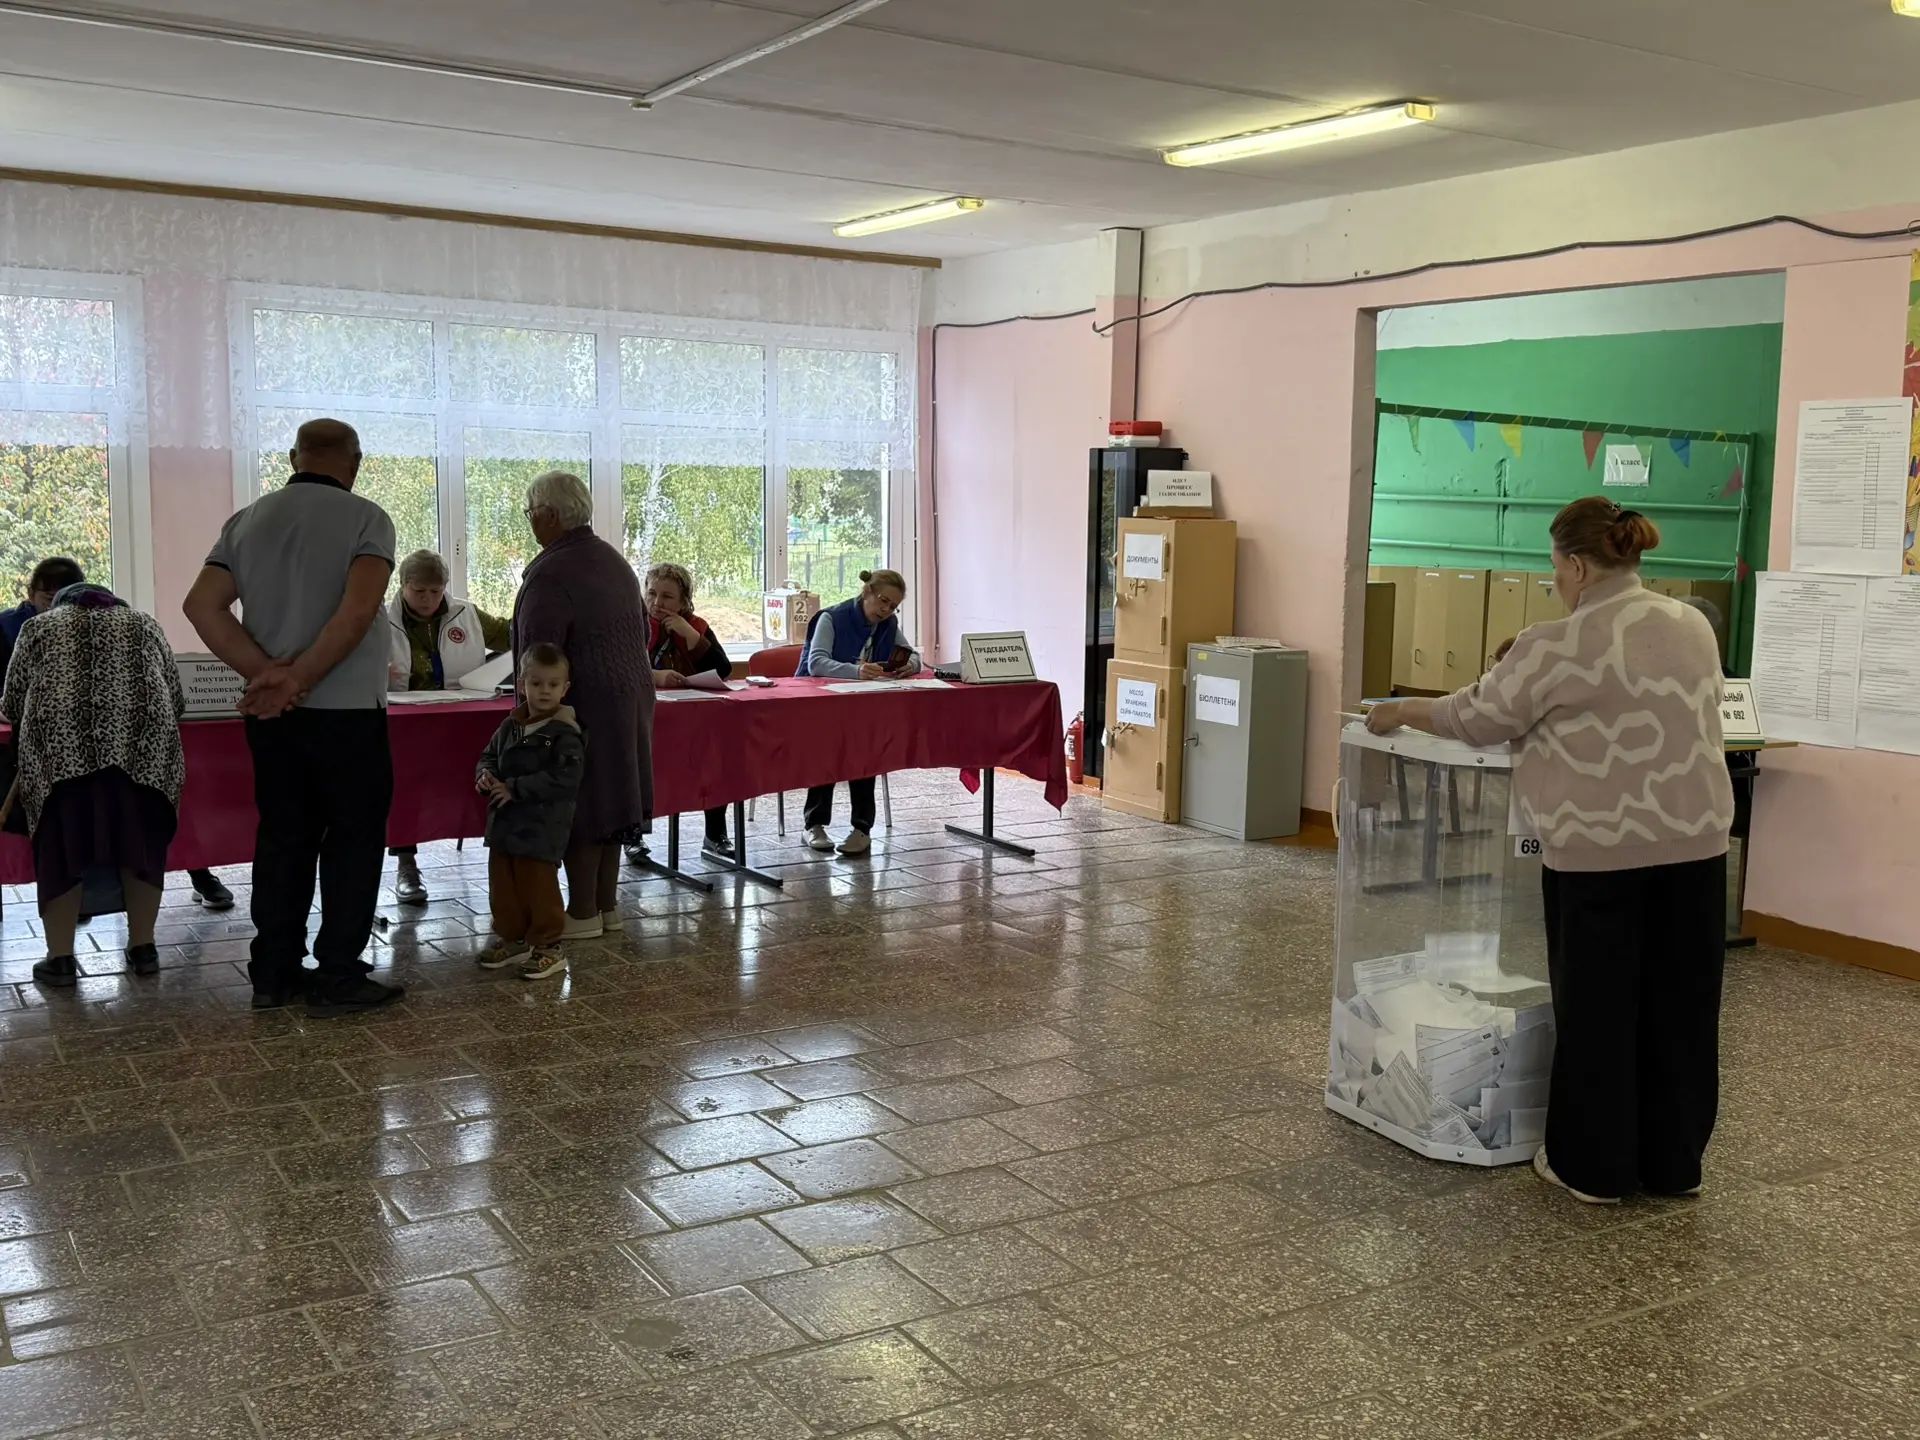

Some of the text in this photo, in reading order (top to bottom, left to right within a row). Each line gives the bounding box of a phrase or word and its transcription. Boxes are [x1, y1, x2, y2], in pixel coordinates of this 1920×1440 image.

[1126, 555, 1159, 564] ДОКУМЕНТЫ
[795, 601, 805, 614] 2
[794, 614, 808, 622] 692
[975, 645, 1024, 654] ПРЕДСЕДАТЕЛЬ
[193, 676, 239, 684] депутатов
[189, 686, 241, 694] Московско
[184, 696, 227, 705] бластной
[1199, 694, 1236, 707] БЮЛЛЕТЕНИ
[1723, 690, 1745, 702] ЬНЫЙ
[1125, 698, 1147, 708] ХРАНЕНИЯ
[1723, 710, 1745, 720] № 692
